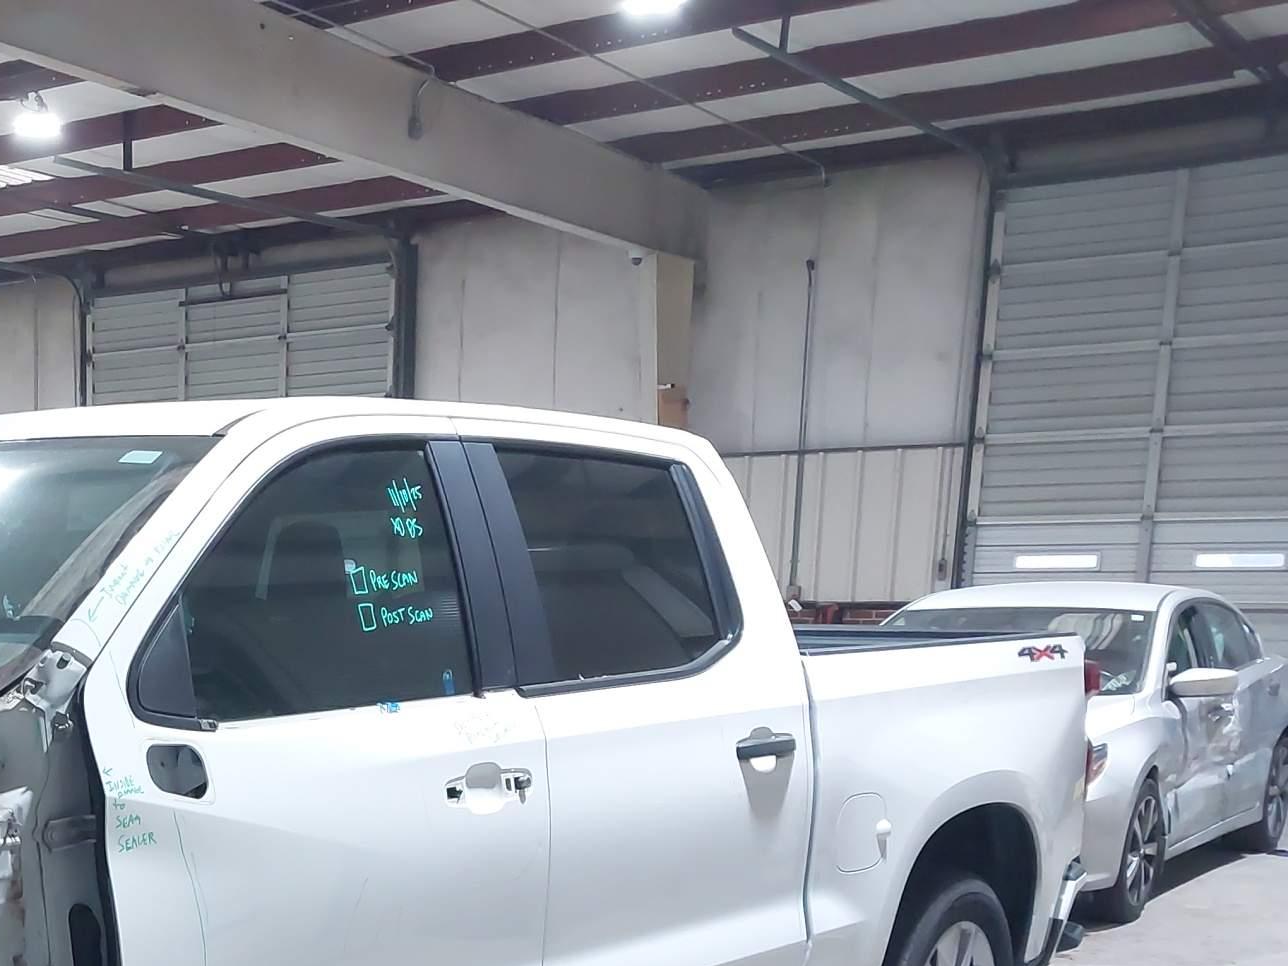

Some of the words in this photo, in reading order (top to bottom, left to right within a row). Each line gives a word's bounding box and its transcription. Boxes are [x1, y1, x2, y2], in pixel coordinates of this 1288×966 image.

[391, 570, 418, 591] SCAN
[381, 606, 406, 628] POST
[407, 606, 433, 625] SCAN
